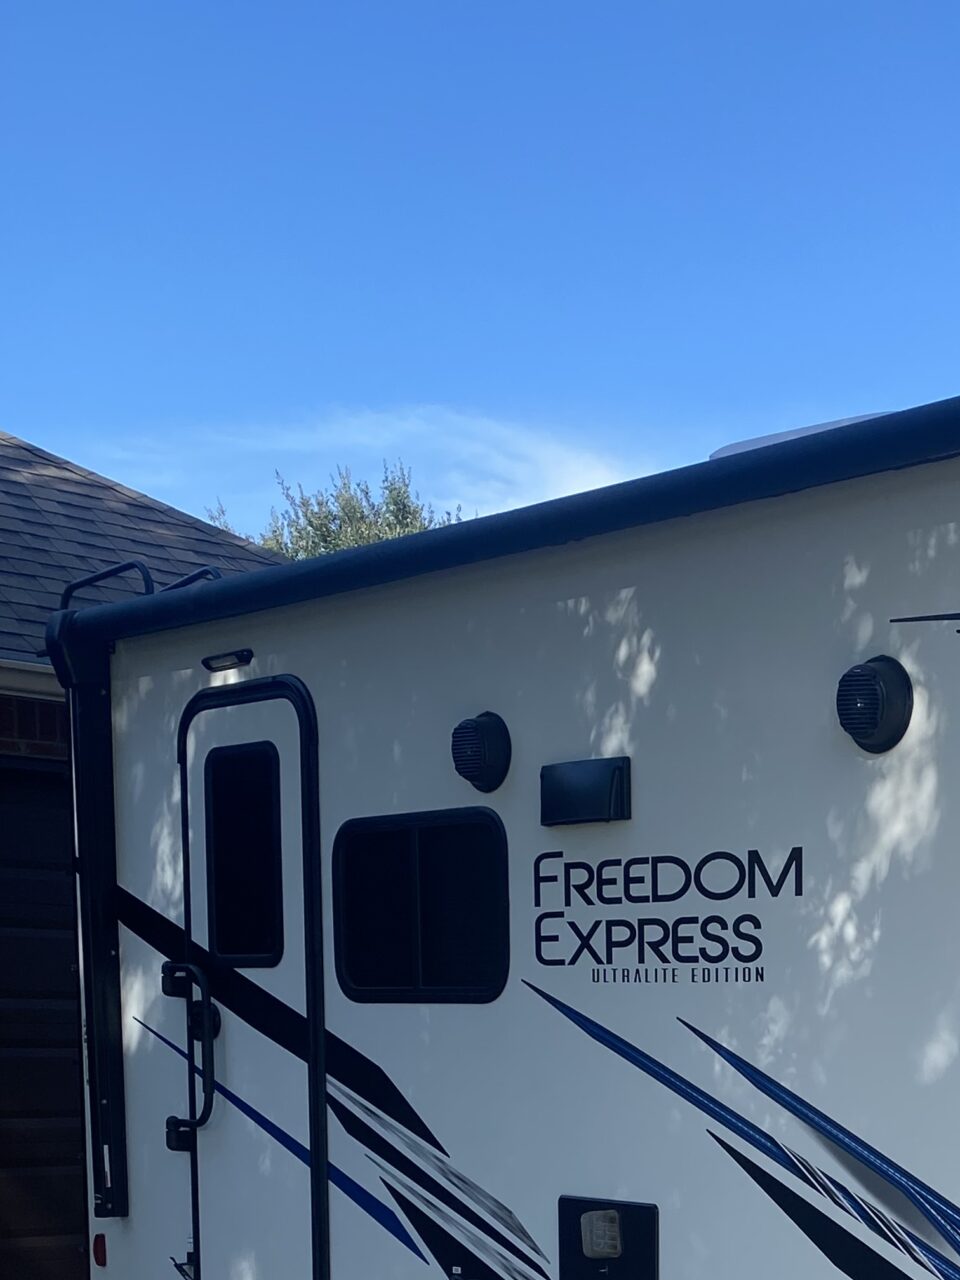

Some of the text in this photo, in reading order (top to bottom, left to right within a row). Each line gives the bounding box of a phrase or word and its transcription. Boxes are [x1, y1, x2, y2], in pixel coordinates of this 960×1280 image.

[534, 846, 803, 907] FREEDOM
[534, 911, 763, 966] EXPRESS
[591, 966, 765, 983] ULTRALITE EDITION
